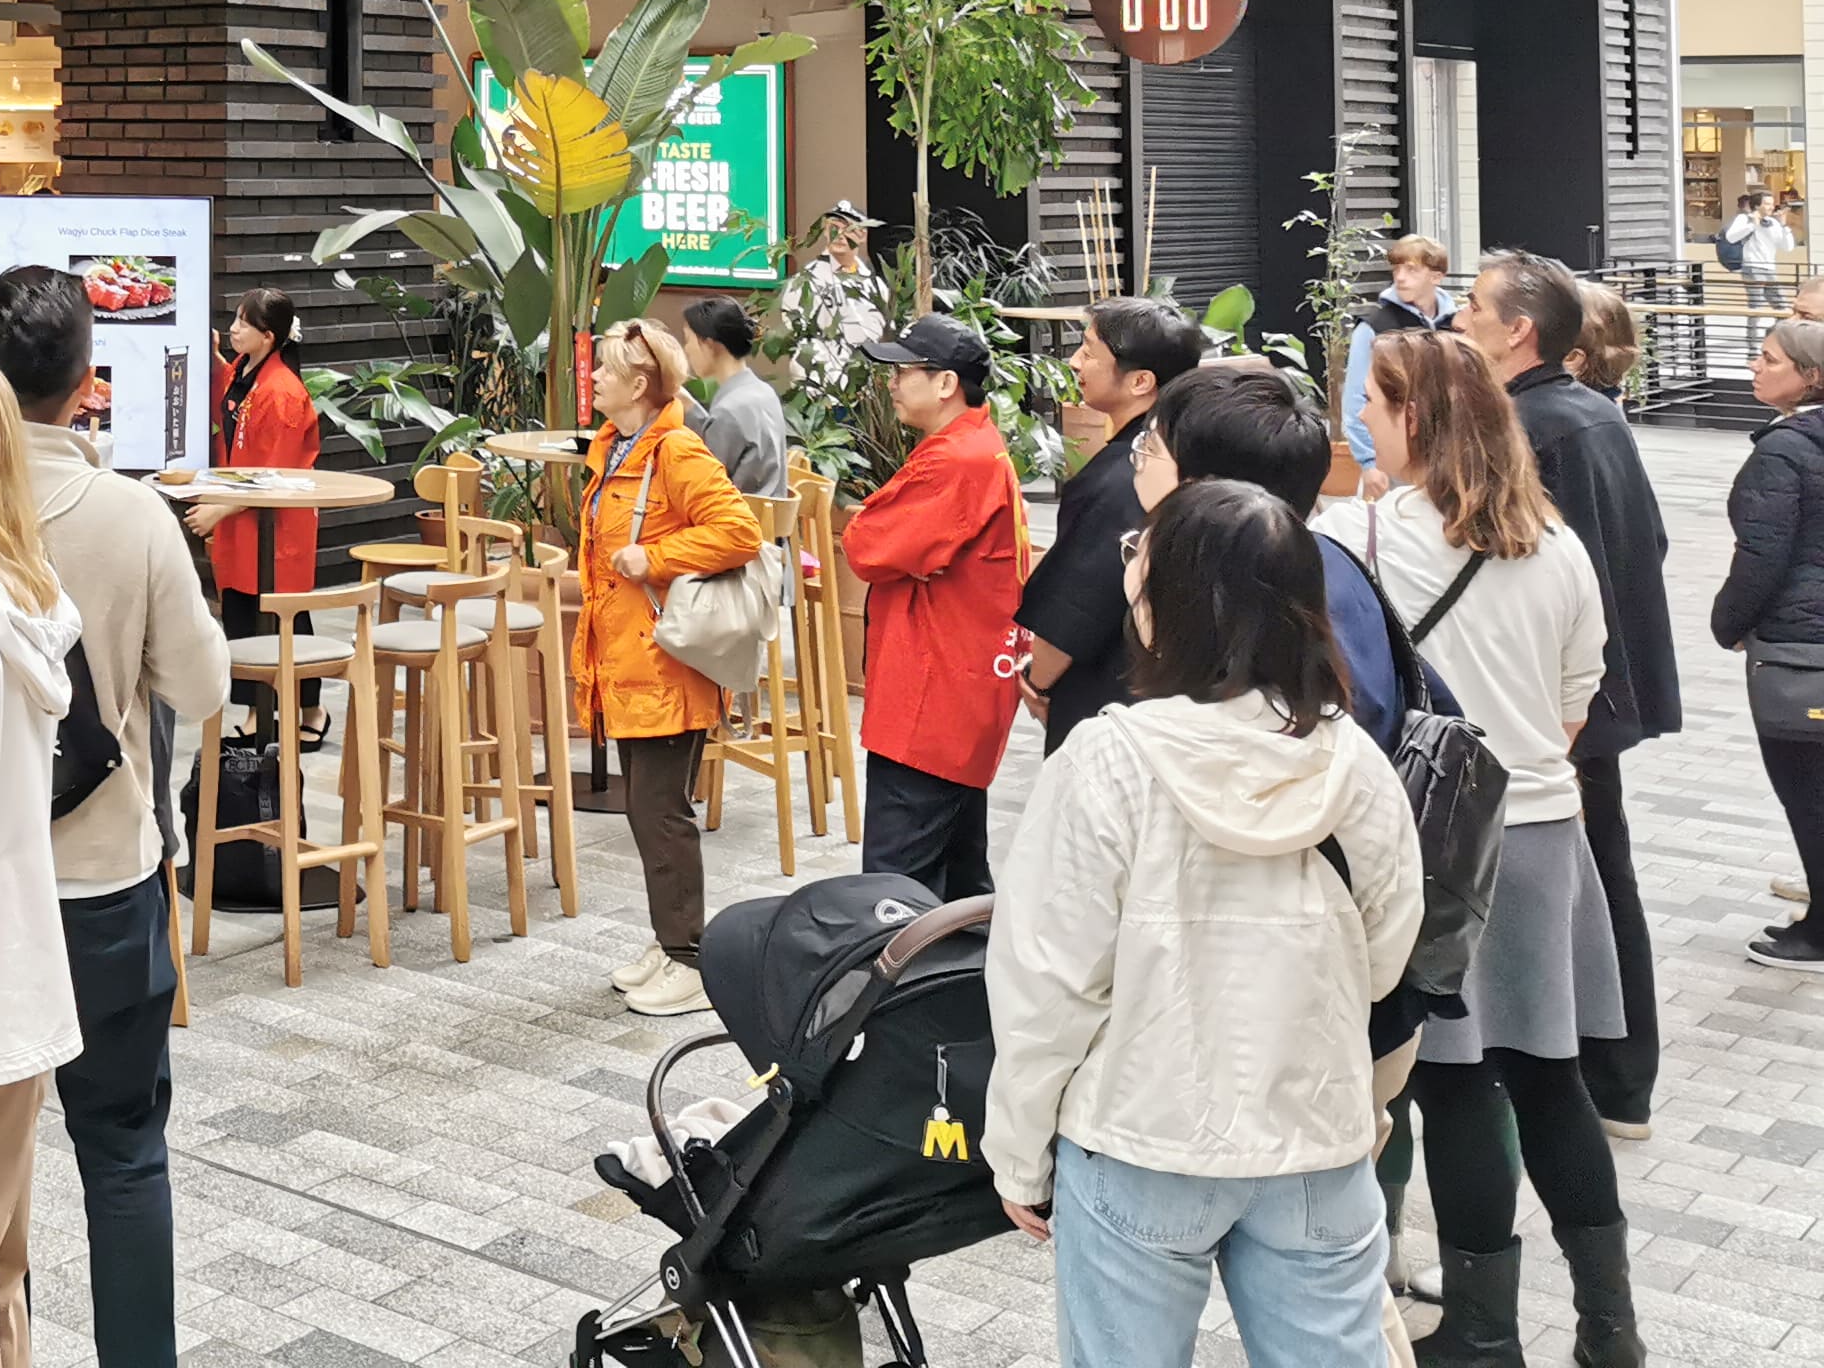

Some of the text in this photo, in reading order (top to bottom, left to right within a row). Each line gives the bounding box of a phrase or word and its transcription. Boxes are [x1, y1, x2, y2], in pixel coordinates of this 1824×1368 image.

[659, 142, 712, 160] TASTE
[641, 192, 730, 232] BEER
[57, 227, 187, 238] Wagyu Chuck Flap Dice Steak
[661, 233, 711, 251] HERE
